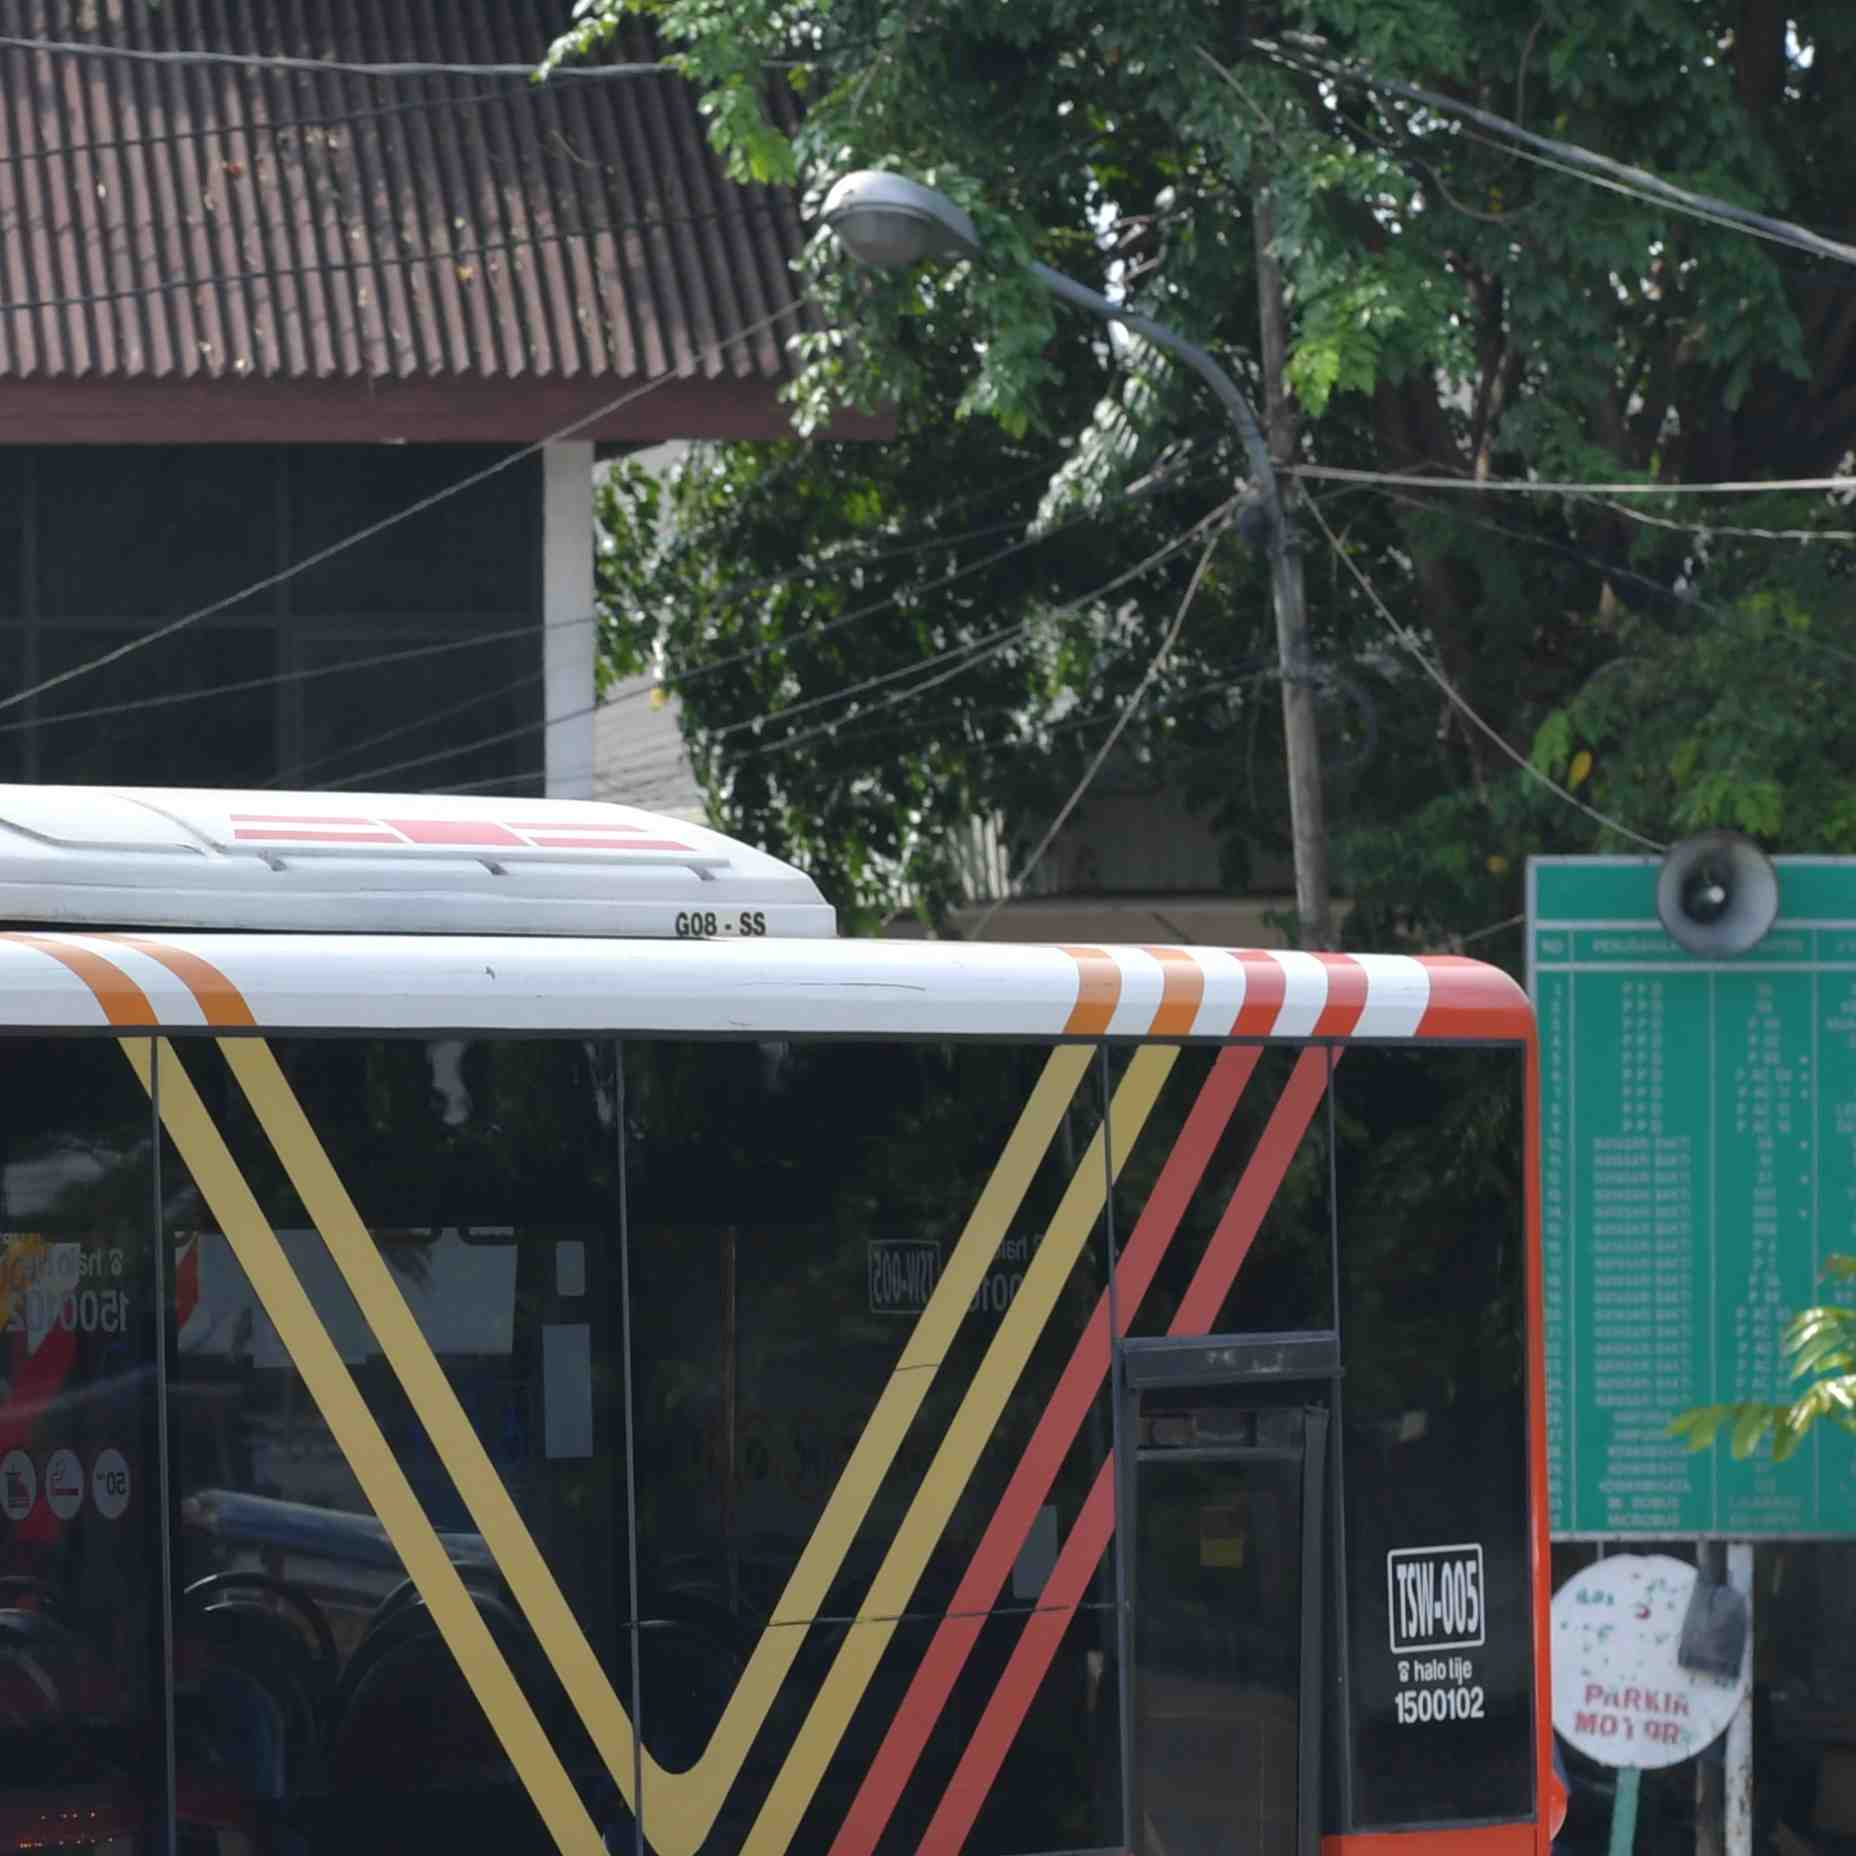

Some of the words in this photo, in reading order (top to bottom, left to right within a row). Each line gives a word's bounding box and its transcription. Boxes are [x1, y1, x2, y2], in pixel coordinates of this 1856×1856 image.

[675, 912, 717, 936] G08
[739, 912, 767, 936] SS
[1396, 1560, 1479, 1638] TSW-005
[1414, 1658, 1447, 1682] halo
[1395, 1686, 1485, 1724] 1500102
